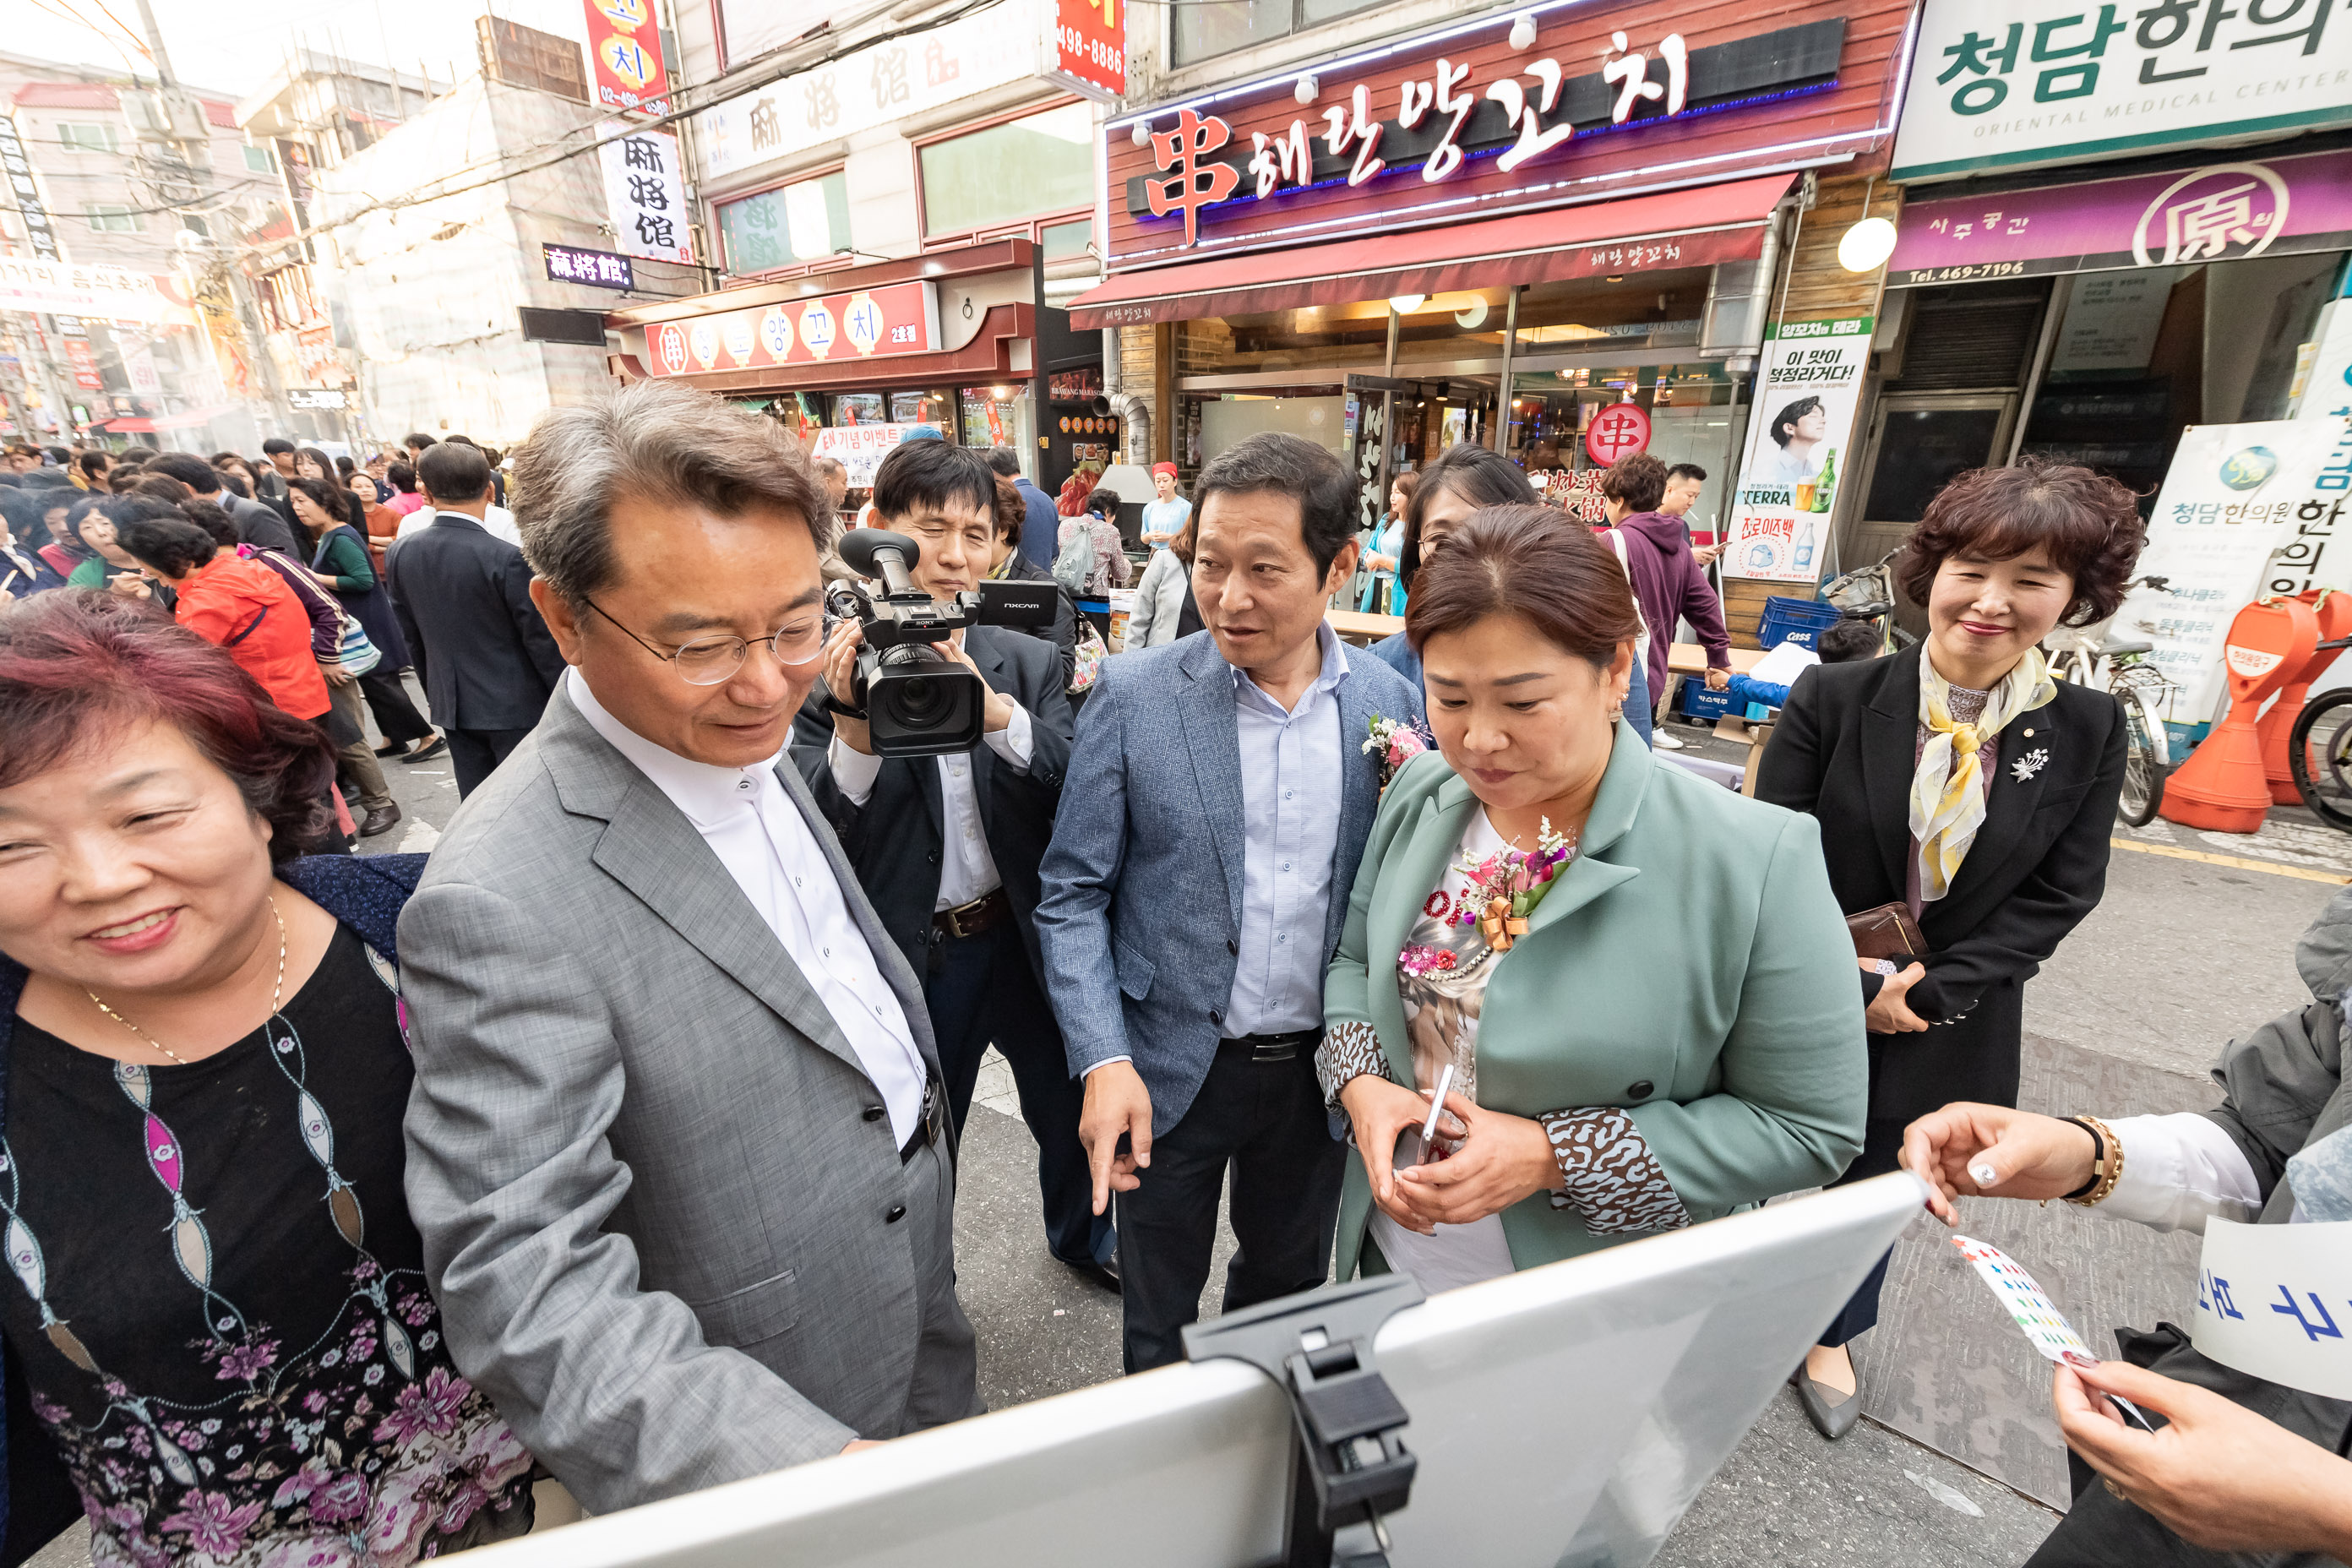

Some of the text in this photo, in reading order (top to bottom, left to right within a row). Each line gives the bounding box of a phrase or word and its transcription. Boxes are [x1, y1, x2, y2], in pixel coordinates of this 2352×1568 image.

[1058, 24, 1122, 74] 498-8886
[1936, 0, 2352, 116] 청담한의
[1249, 30, 1687, 200] 해란양꼬치
[1974, 68, 2349, 139] ORIENTAL MEDICAL CENTER
[1145, 108, 1240, 247] 串
[1930, 211, 2029, 241] 사주공간
[1591, 243, 1680, 266] 해란양꼬치
[0, 264, 57, 286] 거리
[1909, 261, 2024, 283] Tel. 469-7196
[1832, 319, 1862, 335] 테라
[1786, 348, 1843, 366] 이 맛이
[839, 432, 861, 449] 기념
[863, 427, 901, 448] 이벤트
[1596, 412, 1640, 460] 串
[1742, 490, 1791, 506] TERRA
[2172, 501, 2295, 525] 청담한의원
[1786, 631, 1812, 642] Cass
[1697, 694, 1729, 705] 카스맥주
